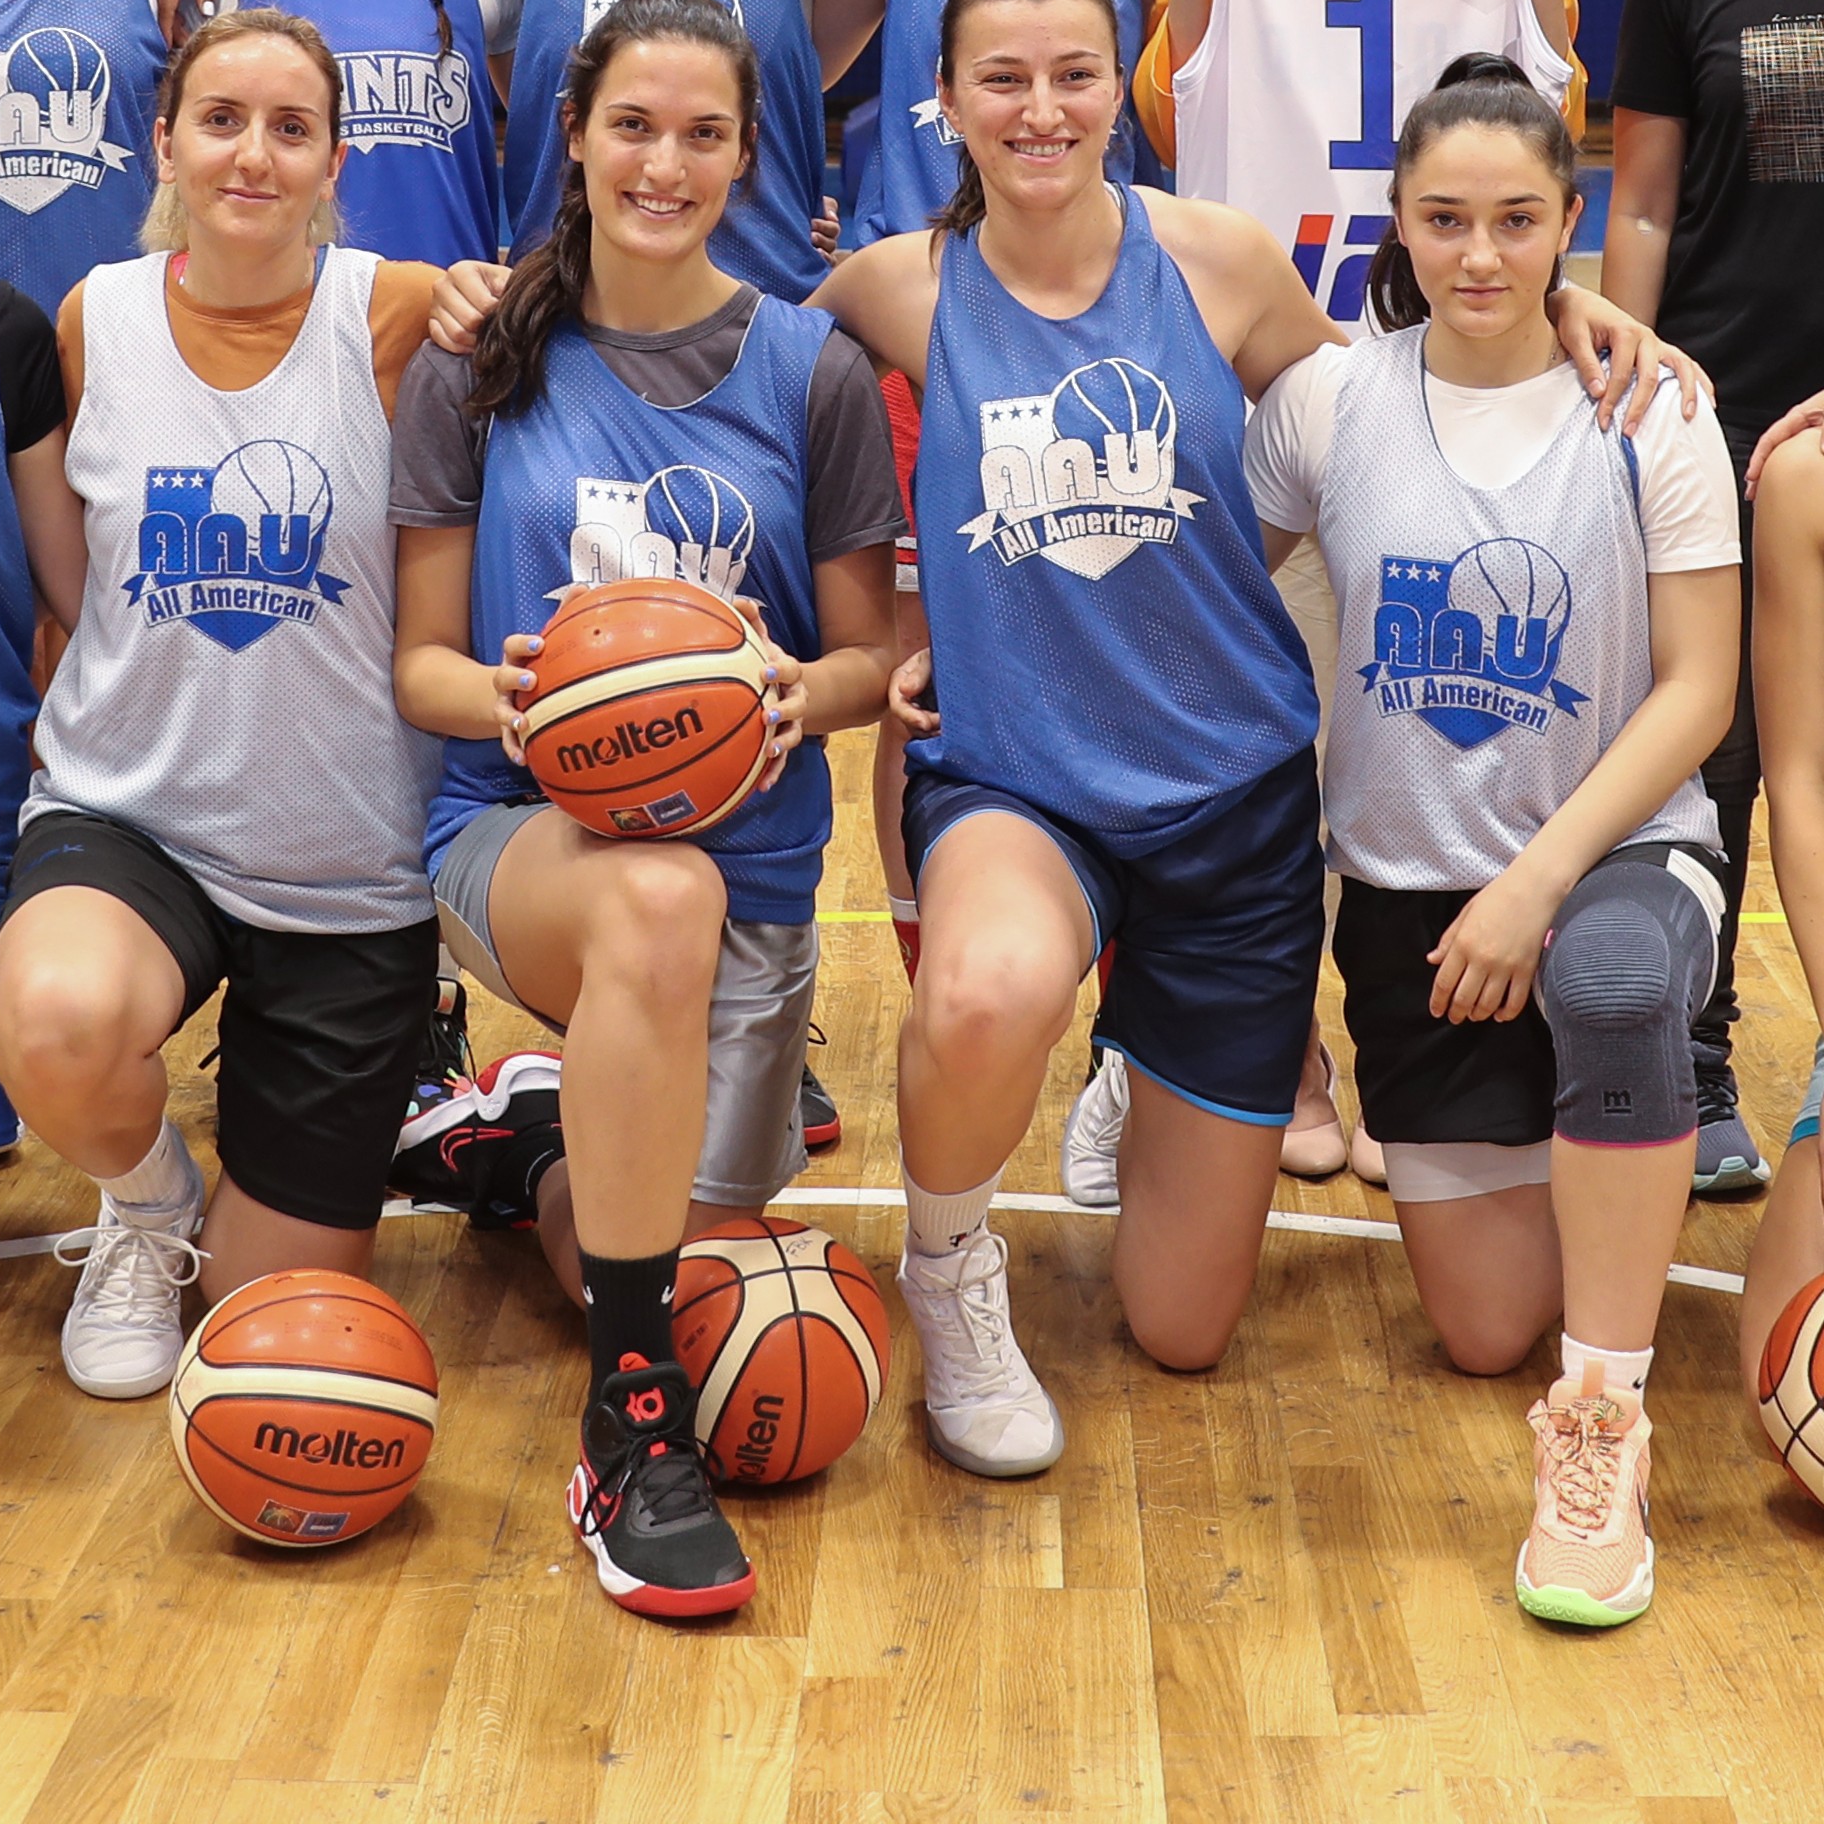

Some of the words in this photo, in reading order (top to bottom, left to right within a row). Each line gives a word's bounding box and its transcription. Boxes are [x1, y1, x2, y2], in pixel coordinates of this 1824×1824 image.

[338, 55, 468, 127] NTS
[352, 122, 446, 142] BASKETBALL
[980, 428, 1164, 511] AAU
[136, 512, 314, 576] AAU
[1000, 521, 1037, 563] All
[1044, 506, 1176, 543] American
[147, 589, 183, 623] All
[190, 580, 316, 622] American
[1373, 602, 1549, 675] AAU
[1379, 680, 1417, 715] All
[1420, 676, 1550, 727] American
[556, 706, 704, 774] molten
[253, 1421, 406, 1469] molten
[735, 1395, 785, 1483] olten
